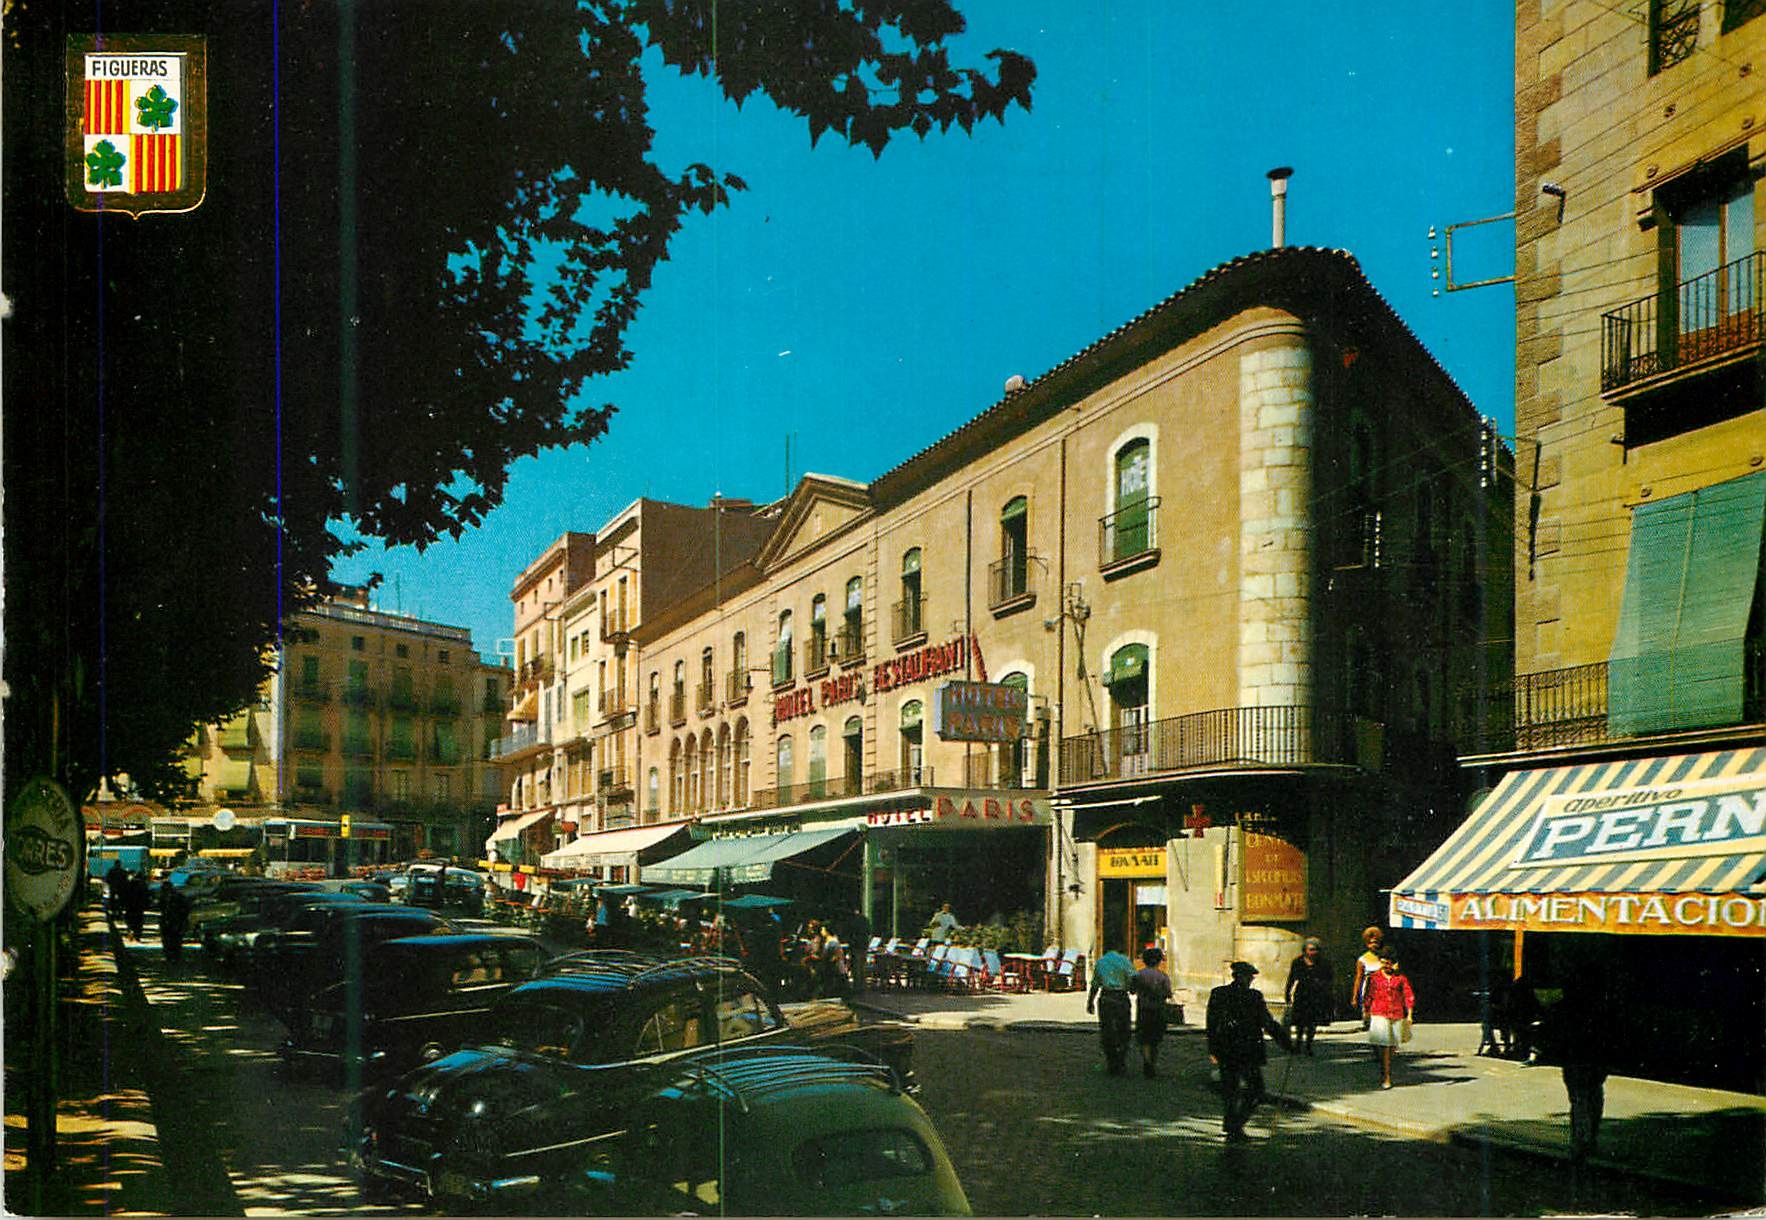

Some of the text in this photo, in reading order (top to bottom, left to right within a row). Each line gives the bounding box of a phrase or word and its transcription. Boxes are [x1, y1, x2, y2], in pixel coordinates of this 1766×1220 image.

[776, 686, 817, 722] HOTEL
[948, 686, 1024, 709] HOTEL
[947, 711, 1020, 740] PARIS
[866, 795, 1035, 825] HOTEL PARIS
[1564, 788, 1682, 815] aperitivo
[1459, 894, 1766, 927] ALIMENTACIO
